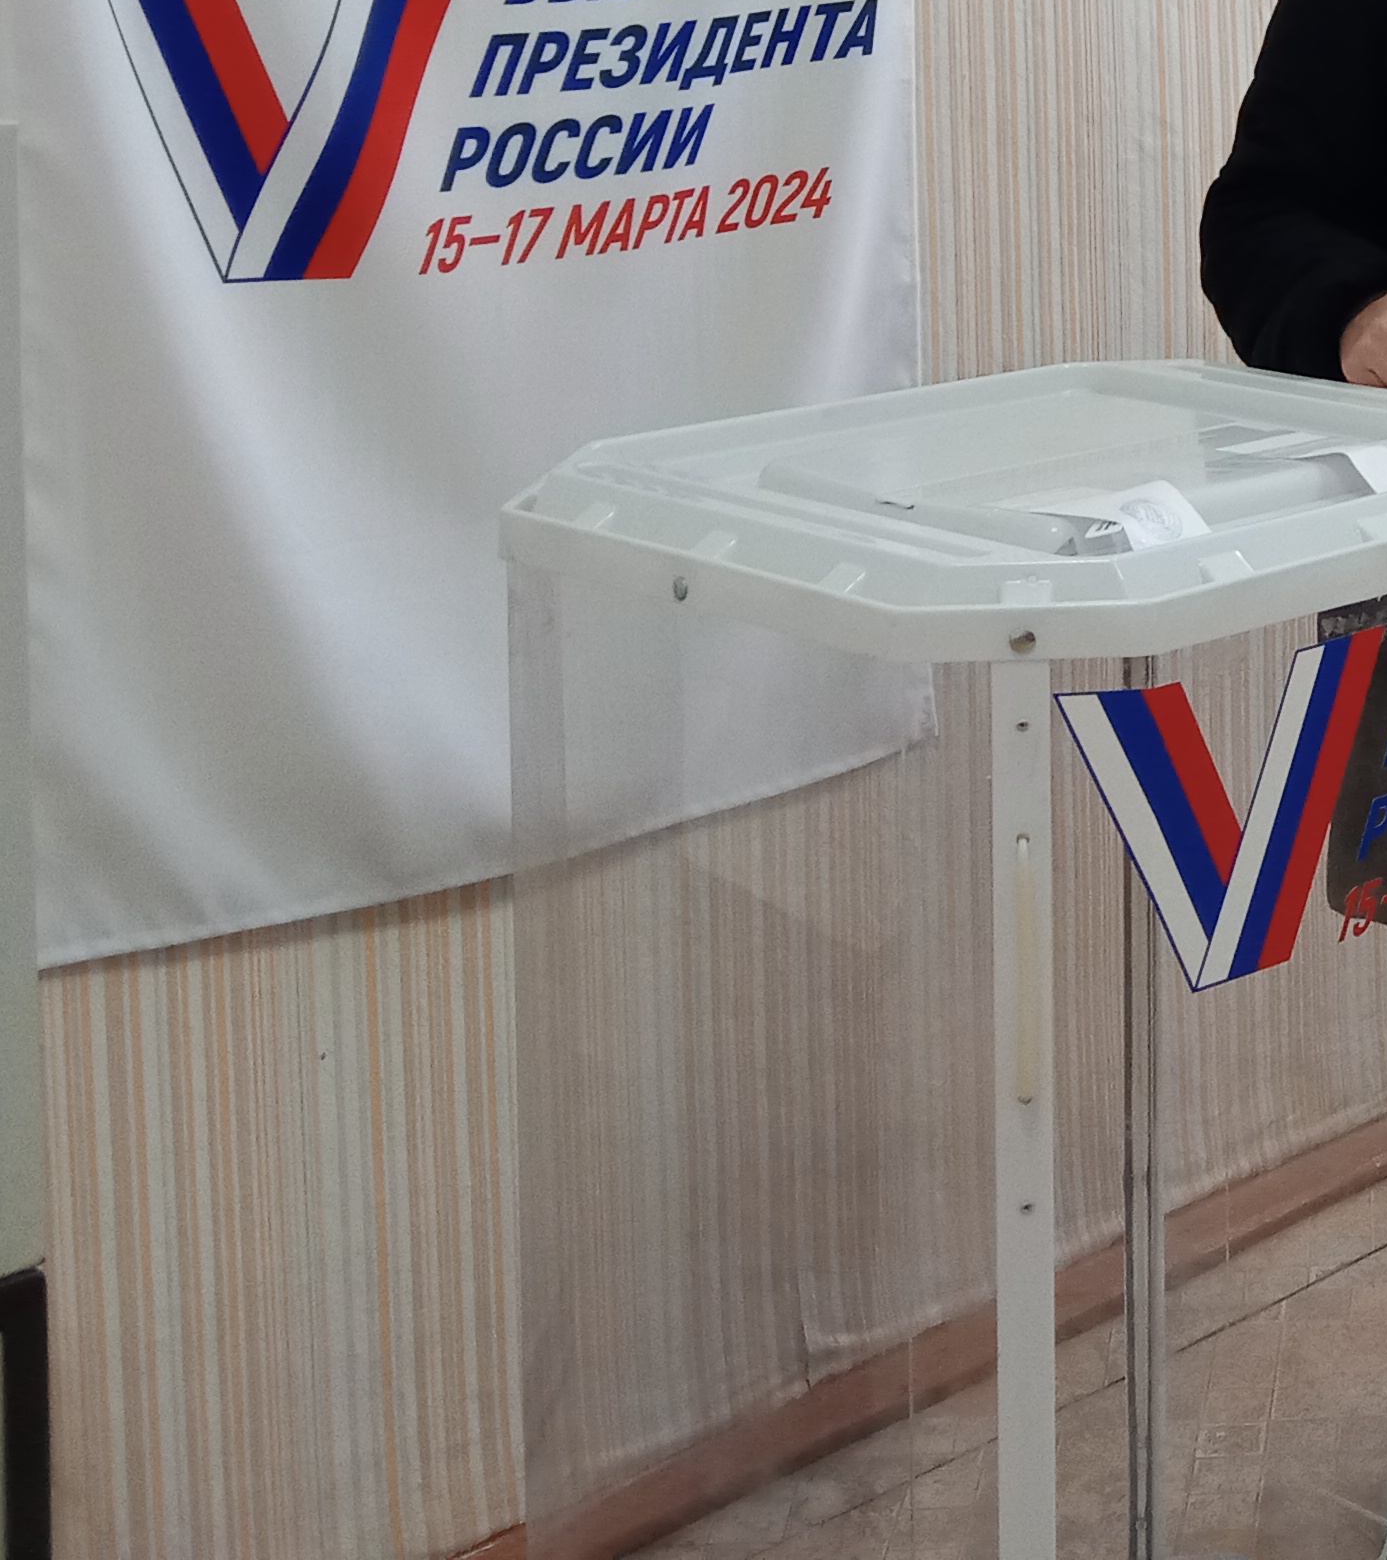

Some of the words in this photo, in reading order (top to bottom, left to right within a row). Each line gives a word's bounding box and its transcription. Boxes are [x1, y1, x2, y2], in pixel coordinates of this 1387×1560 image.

[440, 103, 715, 192] РОССИИ
[556, 185, 710, 259] МАРТА
[716, 166, 833, 234] 2024
